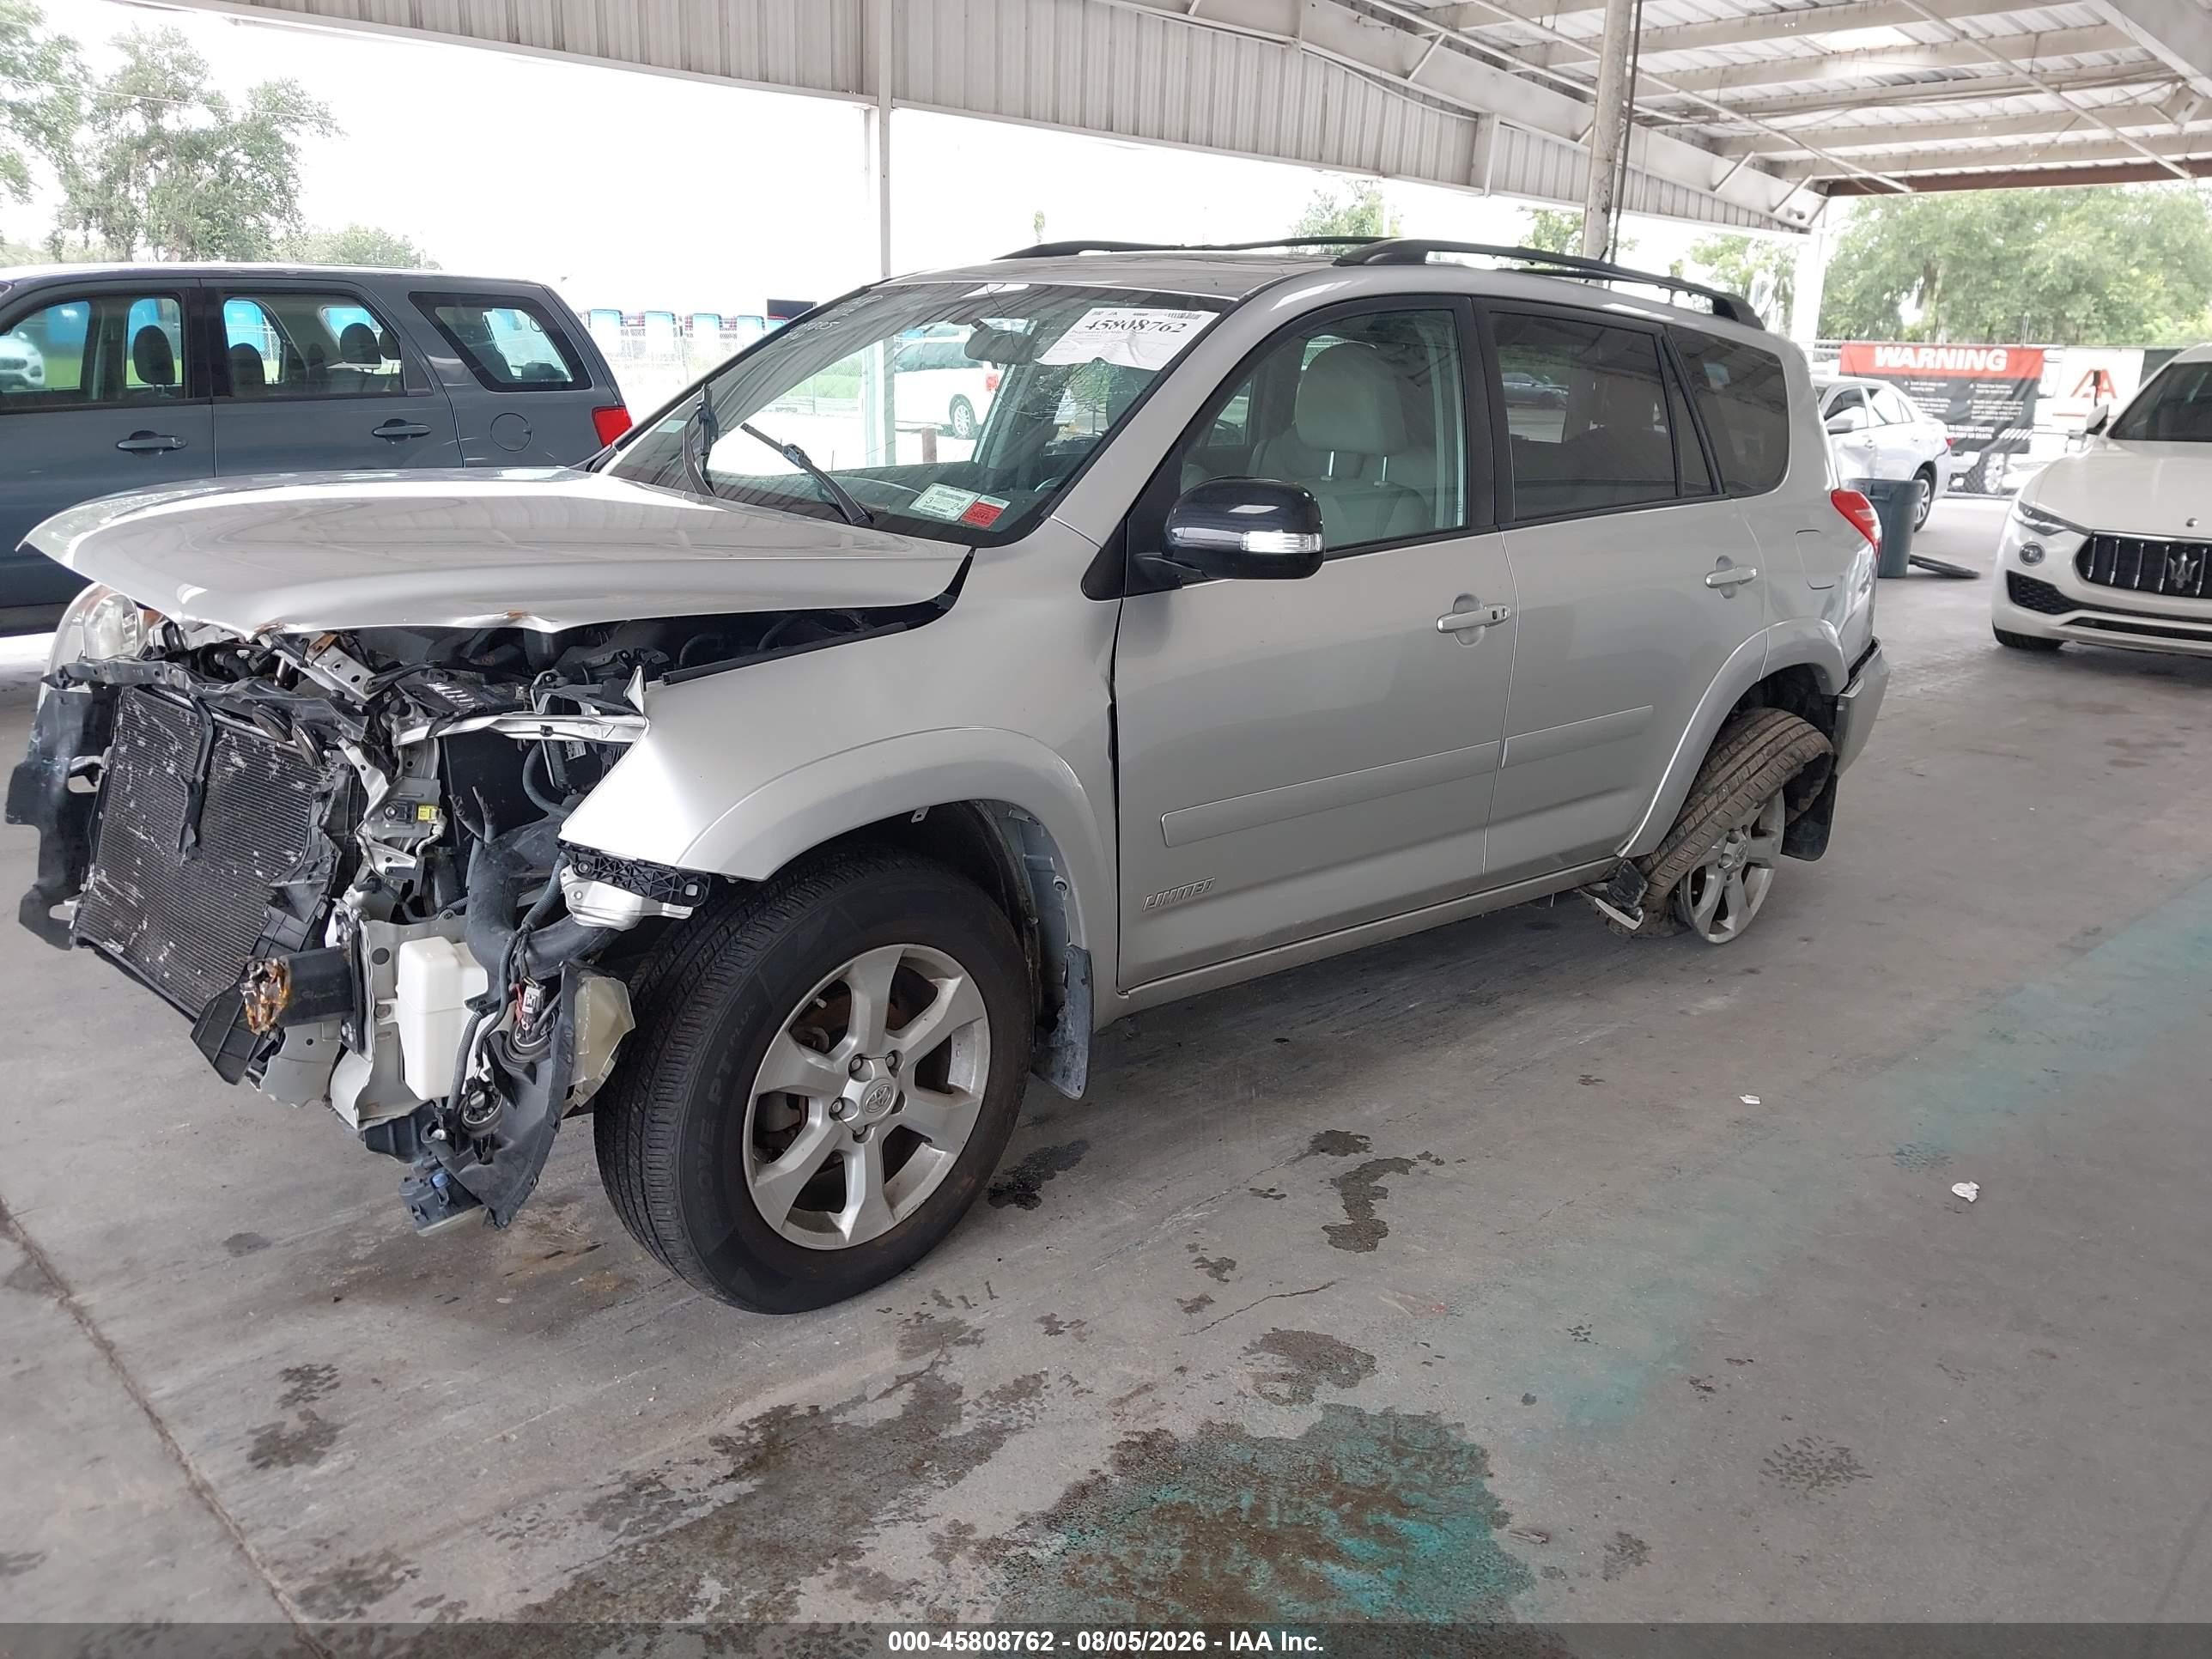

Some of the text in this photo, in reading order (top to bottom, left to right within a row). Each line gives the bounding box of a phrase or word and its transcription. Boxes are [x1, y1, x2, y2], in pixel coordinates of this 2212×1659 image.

[1085, 319, 1188, 333] 45808762
[1875, 347, 2007, 372] WARNING
[1142, 876, 1216, 912] LIMITED
